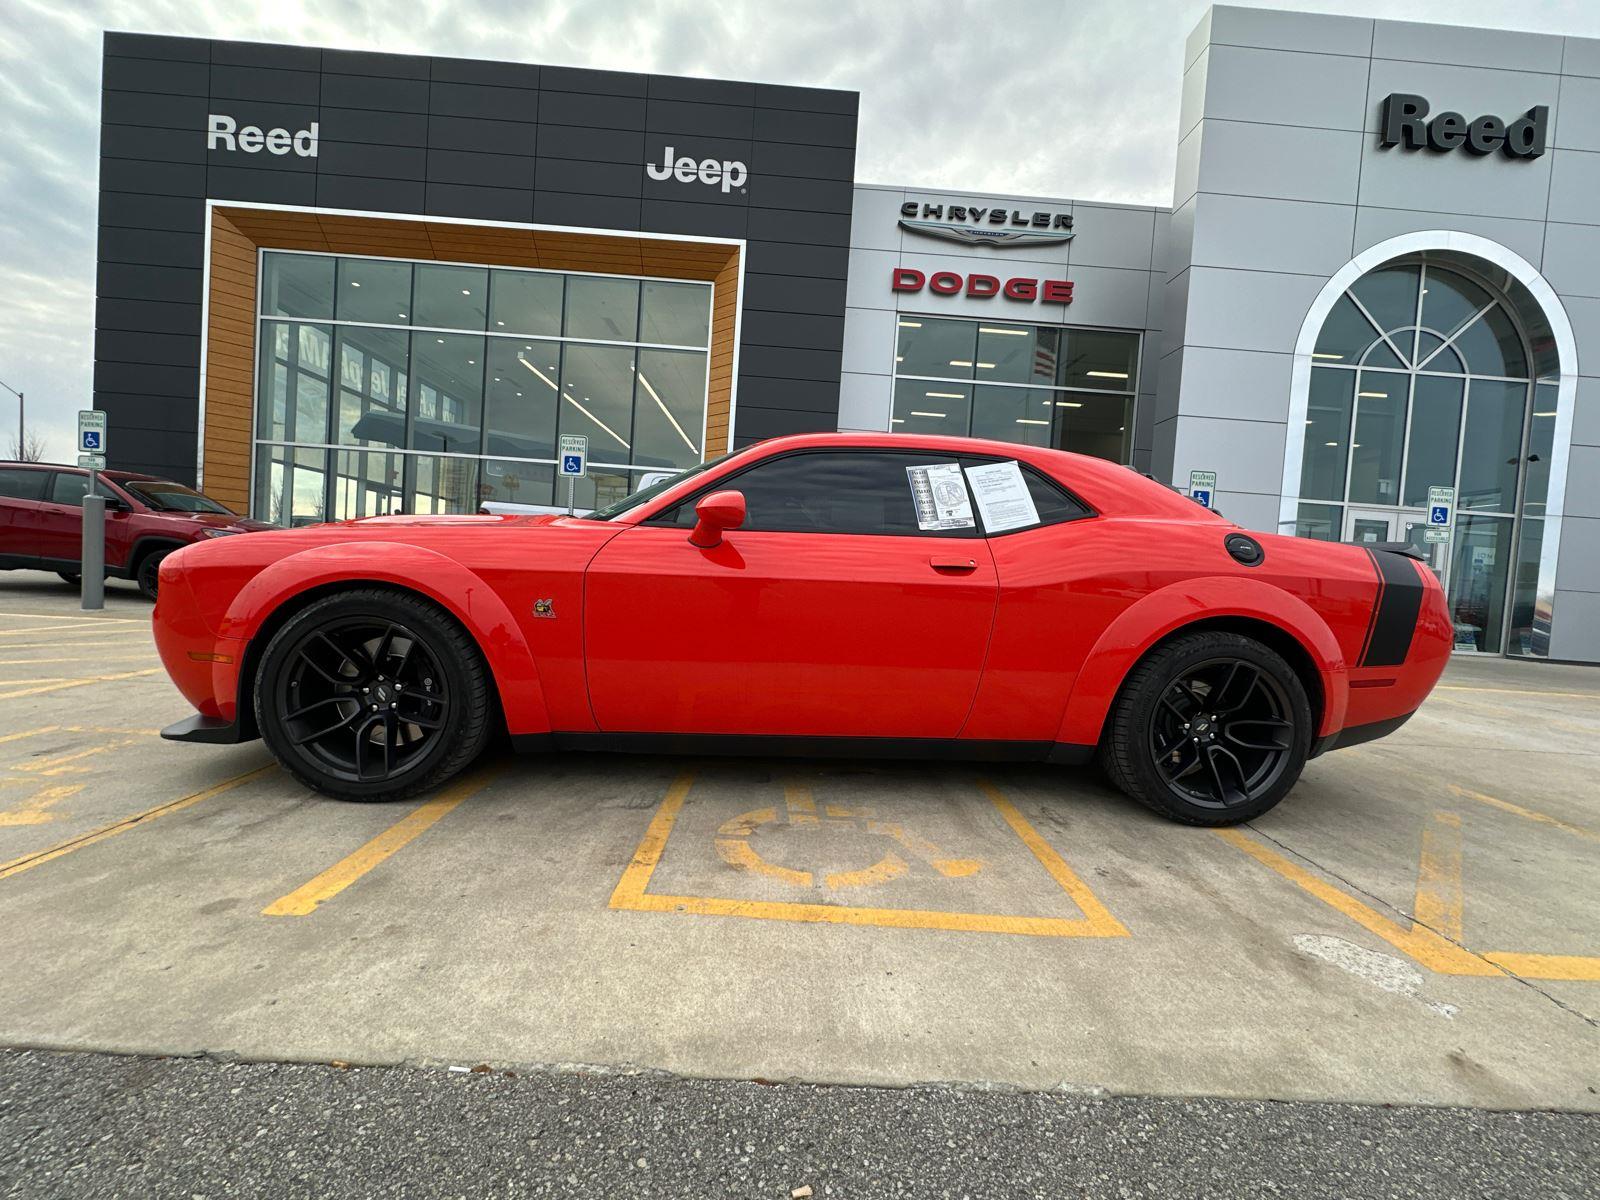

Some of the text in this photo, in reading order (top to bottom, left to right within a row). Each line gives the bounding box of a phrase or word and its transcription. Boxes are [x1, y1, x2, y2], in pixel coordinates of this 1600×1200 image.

[207, 114, 319, 157] Reed
[1380, 93, 1549, 160] Reed
[646, 146, 748, 193] Jeep
[901, 202, 1074, 228] CHRYSLER
[892, 268, 1075, 304] DODGE
[562, 445, 584, 453] PARKING
[1192, 480, 1214, 488] PARKING
[1431, 496, 1452, 504] PARKING
